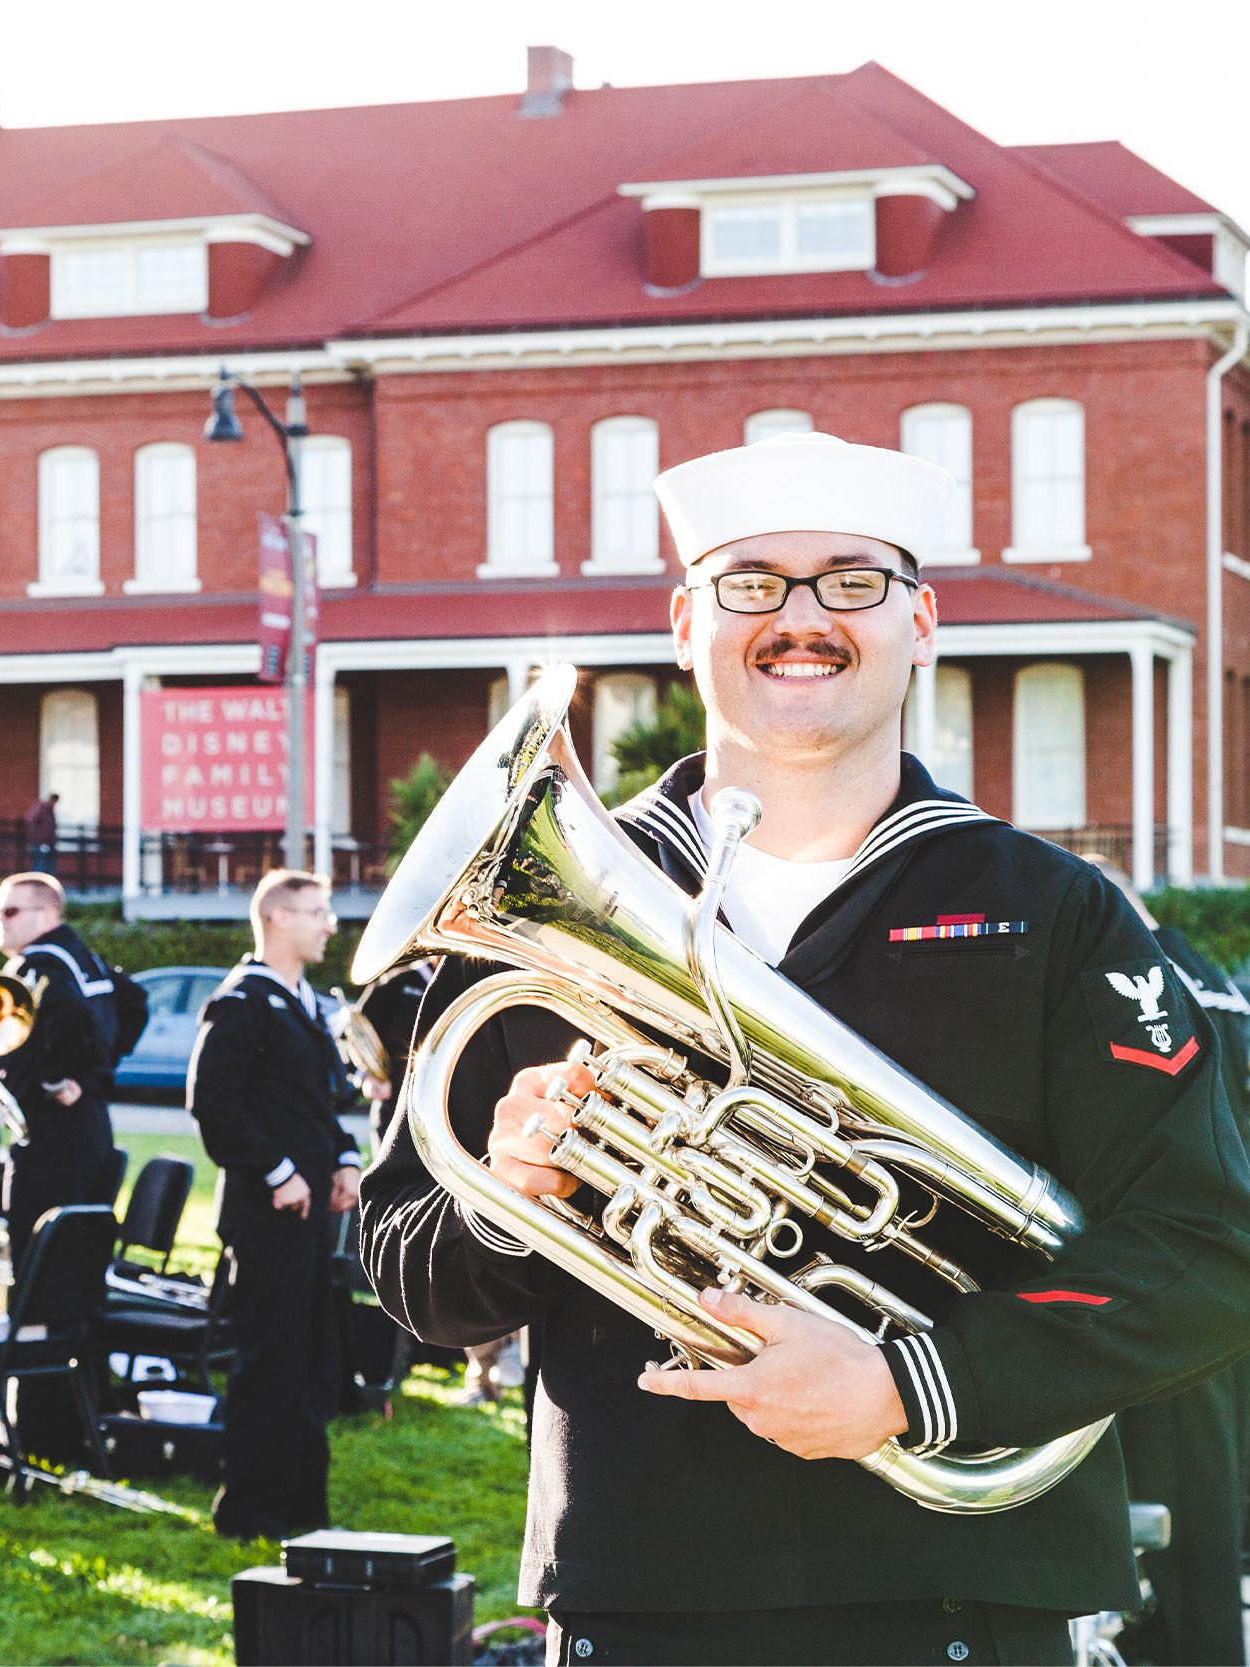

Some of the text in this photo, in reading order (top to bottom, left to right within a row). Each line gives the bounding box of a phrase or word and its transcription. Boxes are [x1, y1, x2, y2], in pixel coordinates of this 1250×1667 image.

[163, 699, 214, 723] THE
[161, 730, 290, 756] DISNEY
[161, 763, 290, 787] FAMILY
